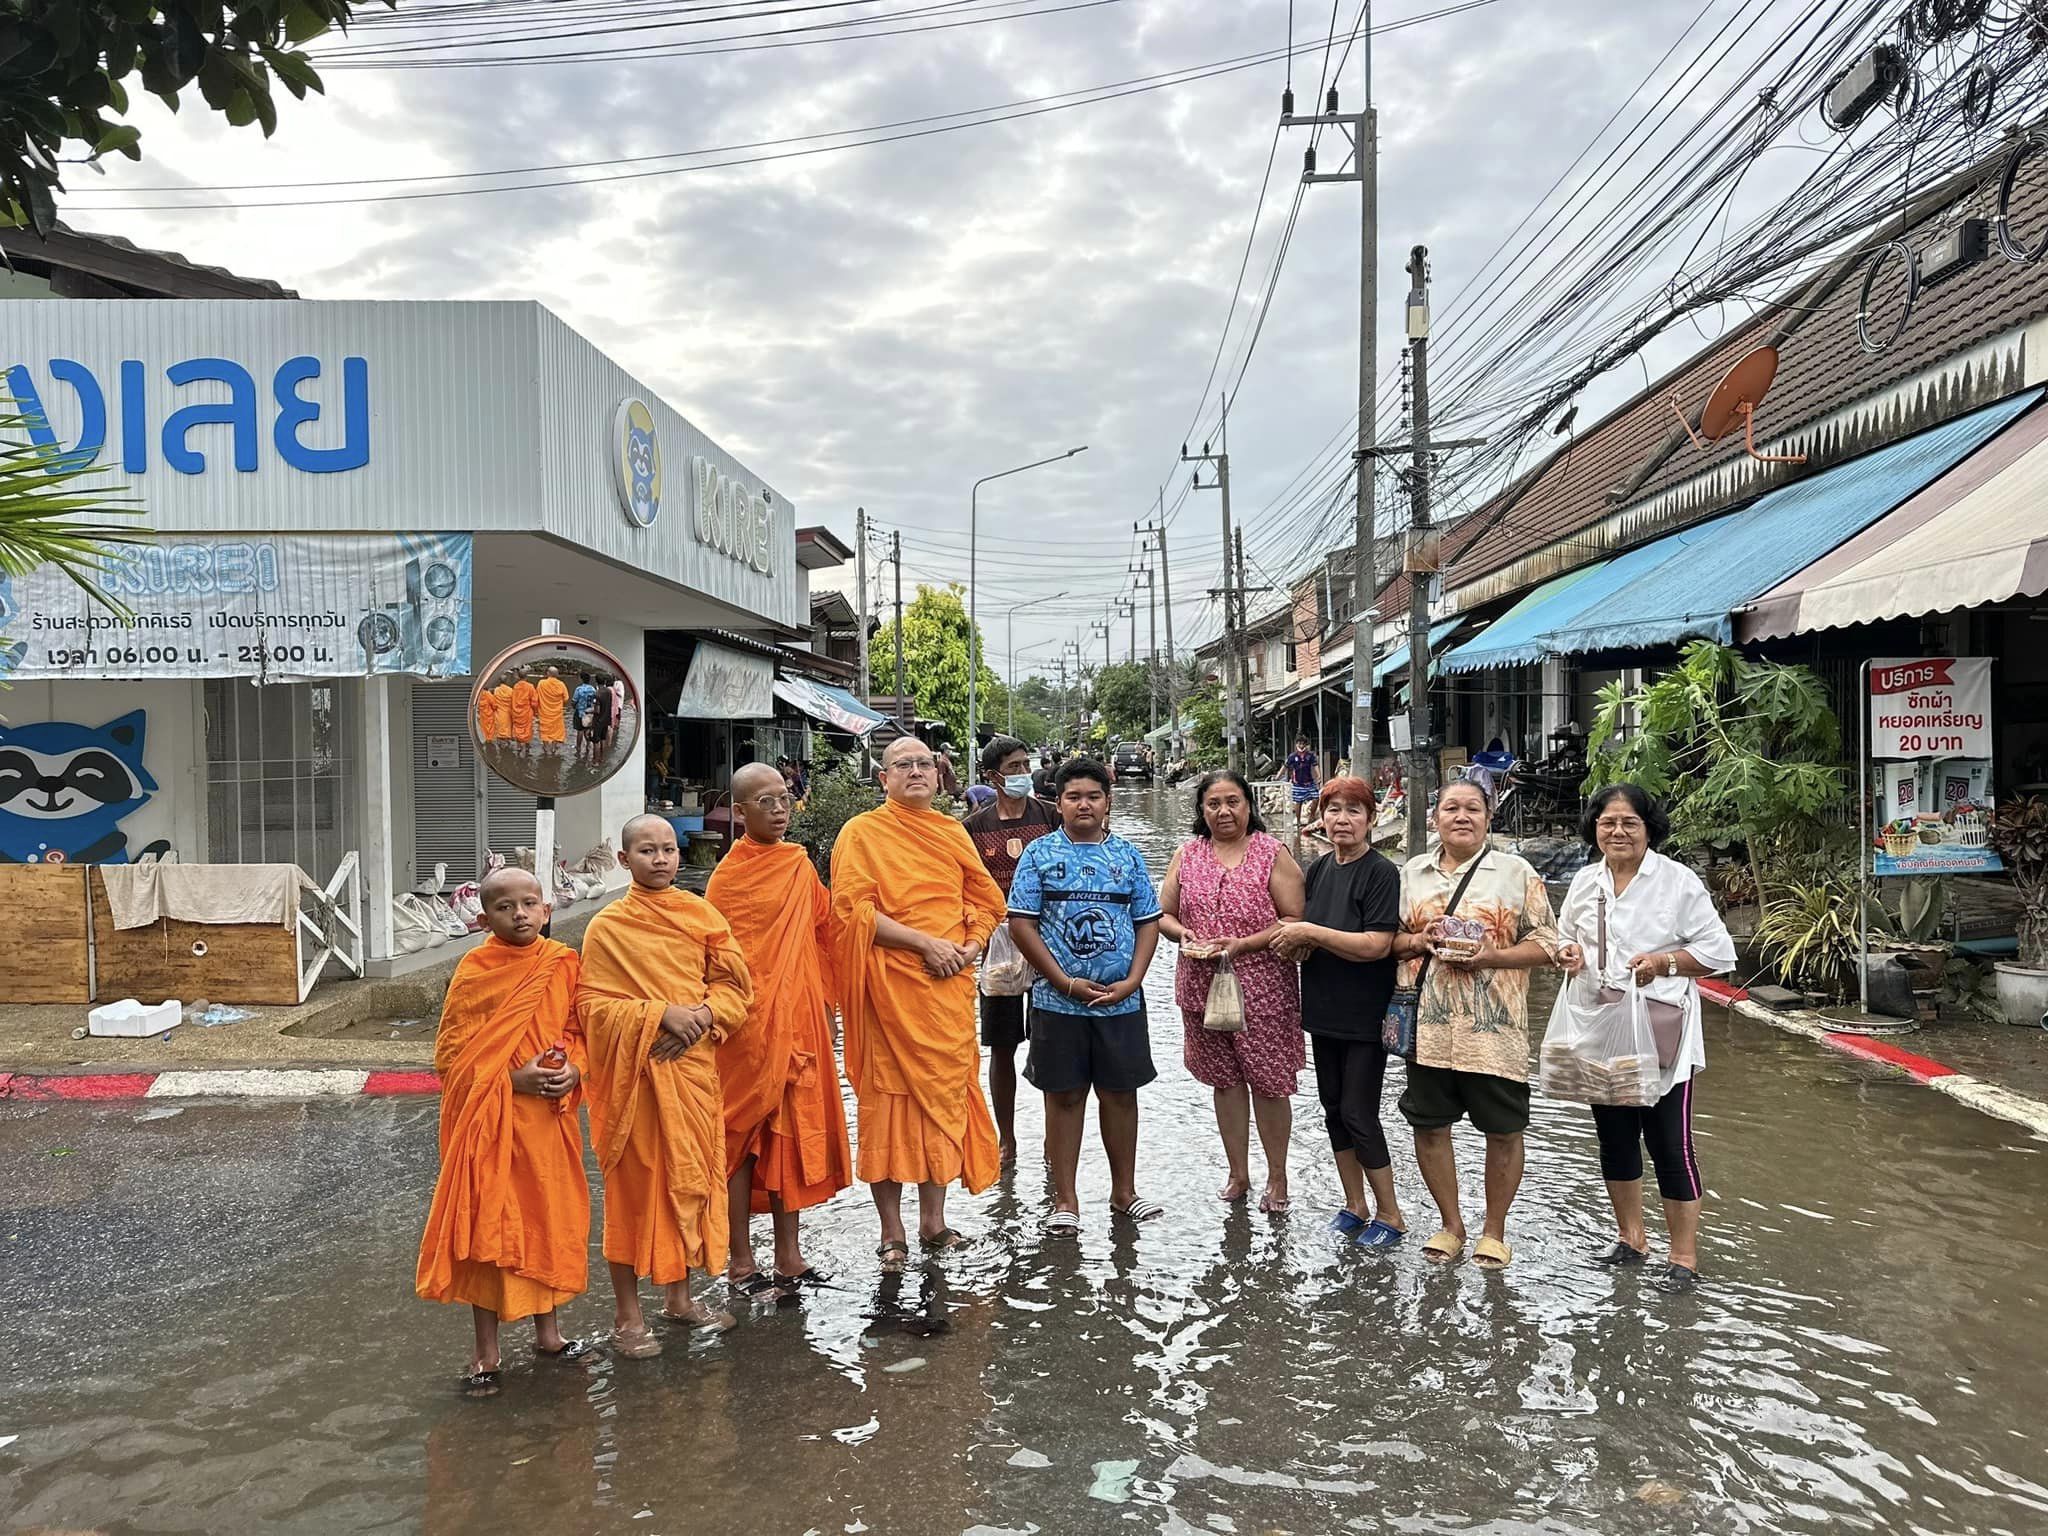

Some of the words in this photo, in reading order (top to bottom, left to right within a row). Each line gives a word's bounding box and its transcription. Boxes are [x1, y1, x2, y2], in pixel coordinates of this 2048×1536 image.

[692, 455, 777, 578] KIREI
[97, 543, 279, 594] KIREI
[209, 610, 346, 632] เปิดบริการทุกวัน
[48, 648, 98, 665] เวลา
[106, 646, 179, 664] 06.00
[187, 648, 209, 663] น.
[313, 647, 334, 662] น.
[1881, 666, 1934, 689] บริการ
[1907, 689, 1952, 709] ซักผ้า
[1879, 709, 1983, 729] หยอดเหรียญ
[1899, 734, 1922, 751] 20
[1927, 736, 1963, 751] บาท
[1899, 784, 1914, 802] 20
[1946, 782, 1968, 801] 20
[1056, 861, 1066, 879] 9
[1068, 892, 1111, 901] AKHILA
[1064, 918, 1115, 942] MS
